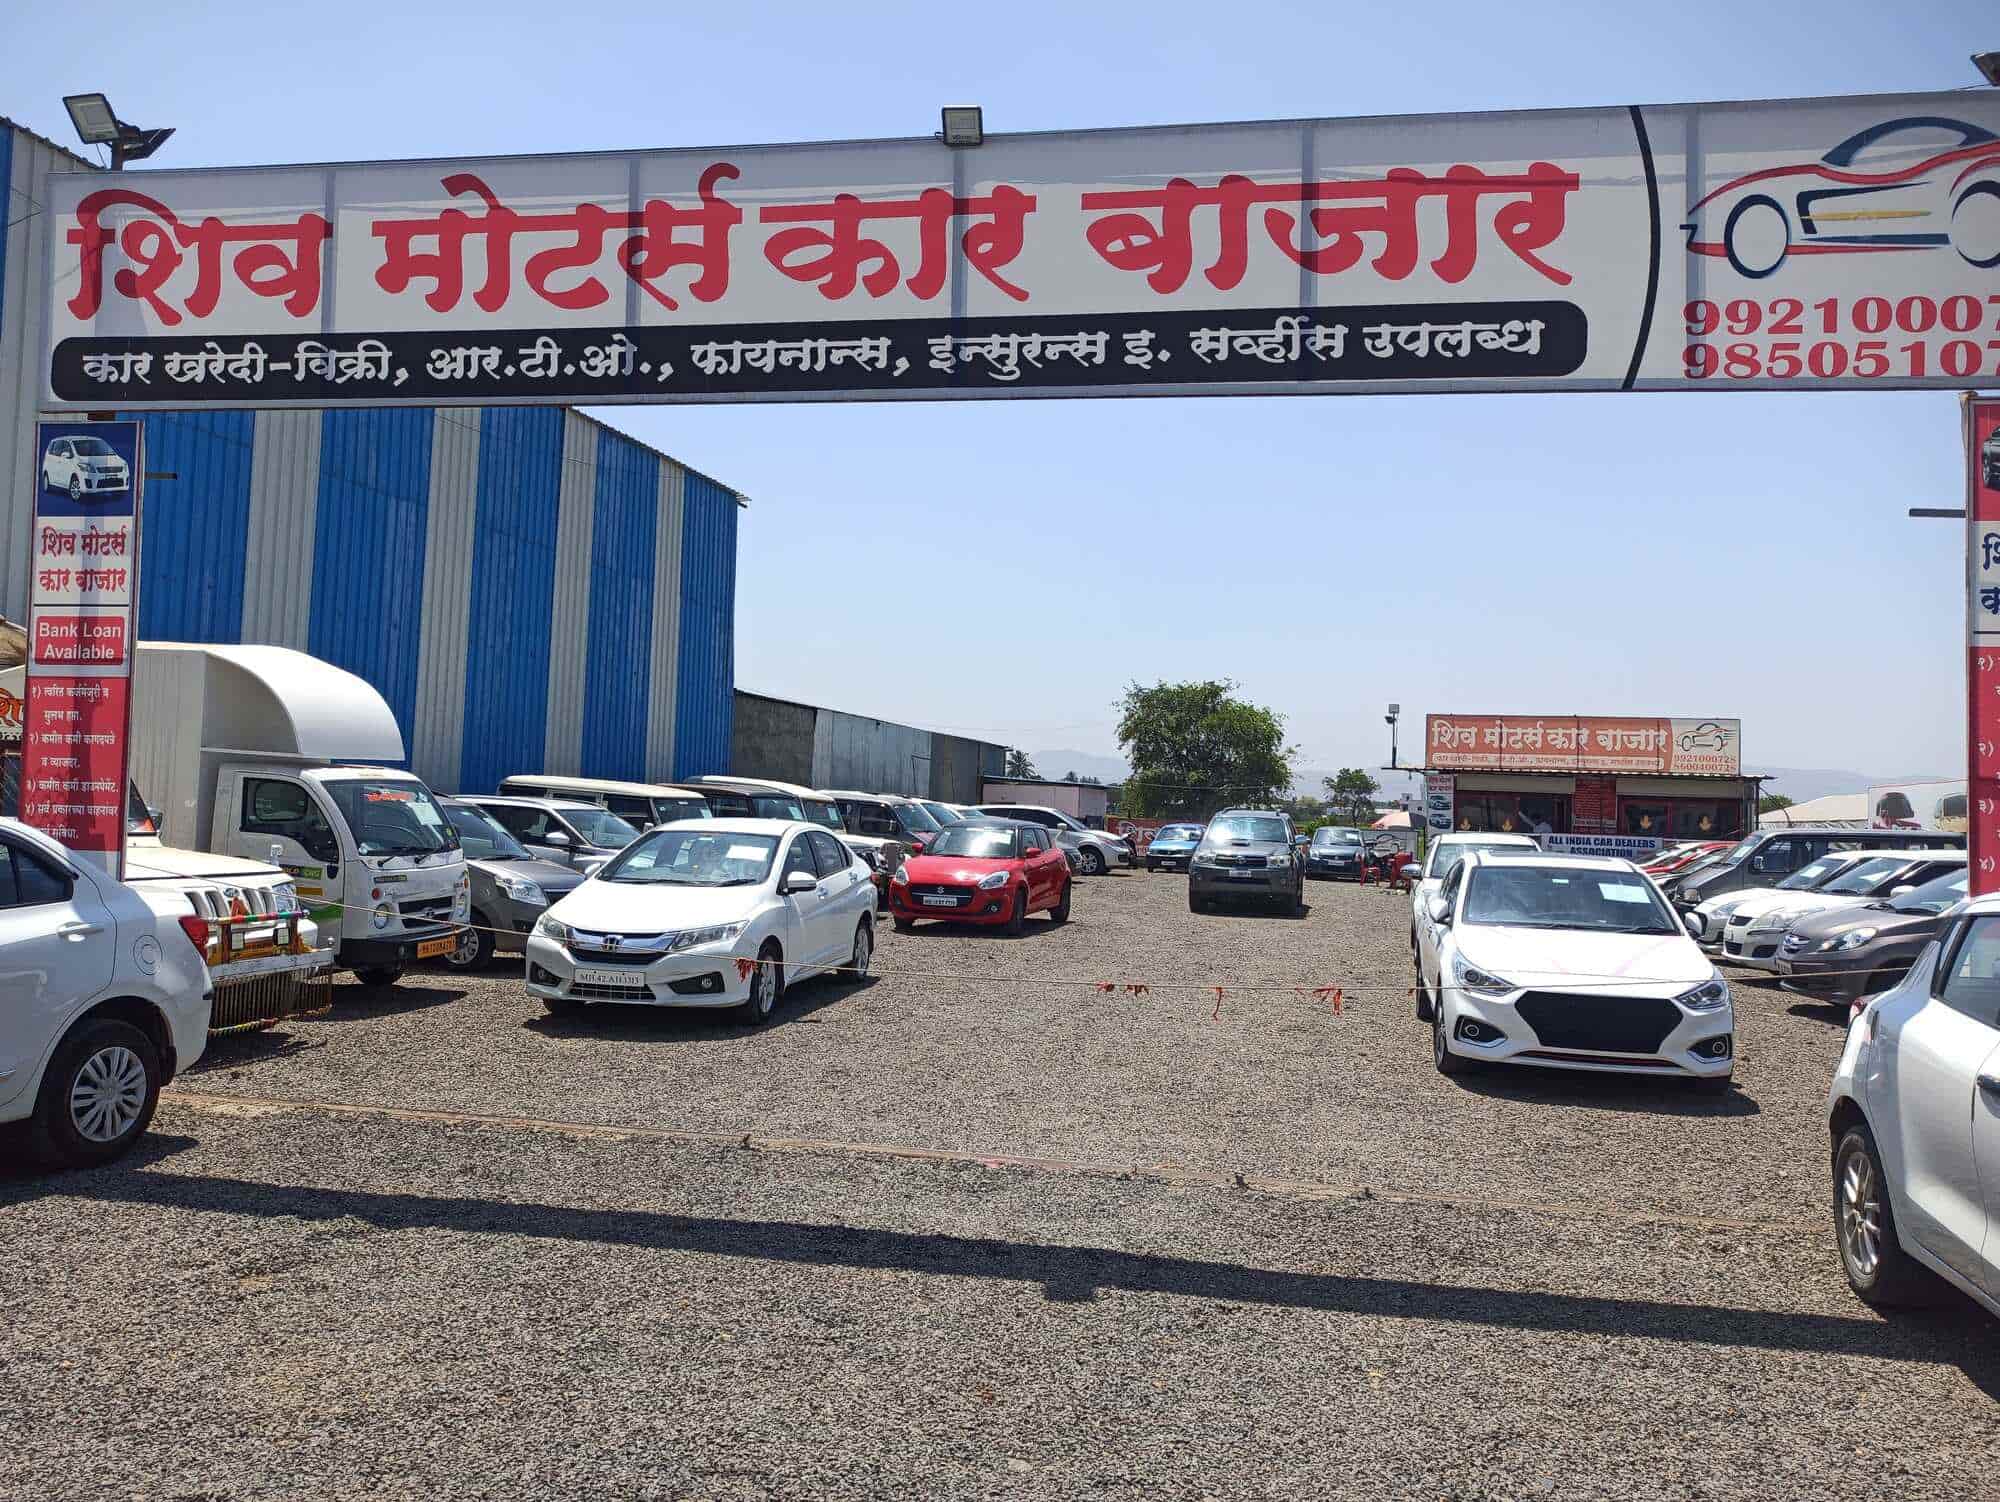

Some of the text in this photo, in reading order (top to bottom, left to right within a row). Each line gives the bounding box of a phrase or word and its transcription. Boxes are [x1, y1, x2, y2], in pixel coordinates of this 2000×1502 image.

[66, 161, 1580, 326] शिव मोटर्स कार बाजार
[82, 351, 154, 384] कार
[163, 339, 409, 387] खरेदी-विक्री,
[691, 336, 911, 378] फायनान्स,
[928, 330, 1109, 381] इन्सुरन्स
[1122, 329, 1171, 369] इ.
[1362, 319, 1544, 359] उपलब्ध
[41, 524, 127, 557] शिव मोटर्स
[39, 567, 127, 593] कार बाजार
[39, 621, 121, 639] Bank Loan
[44, 643, 115, 660] Available
[1432, 719, 1668, 752] शिव मोटर्स कार बाजार
[1549, 835, 1656, 848] ALL INDIA CAR DEALERS
[1570, 846, 1633, 858] ASSOCIATION
